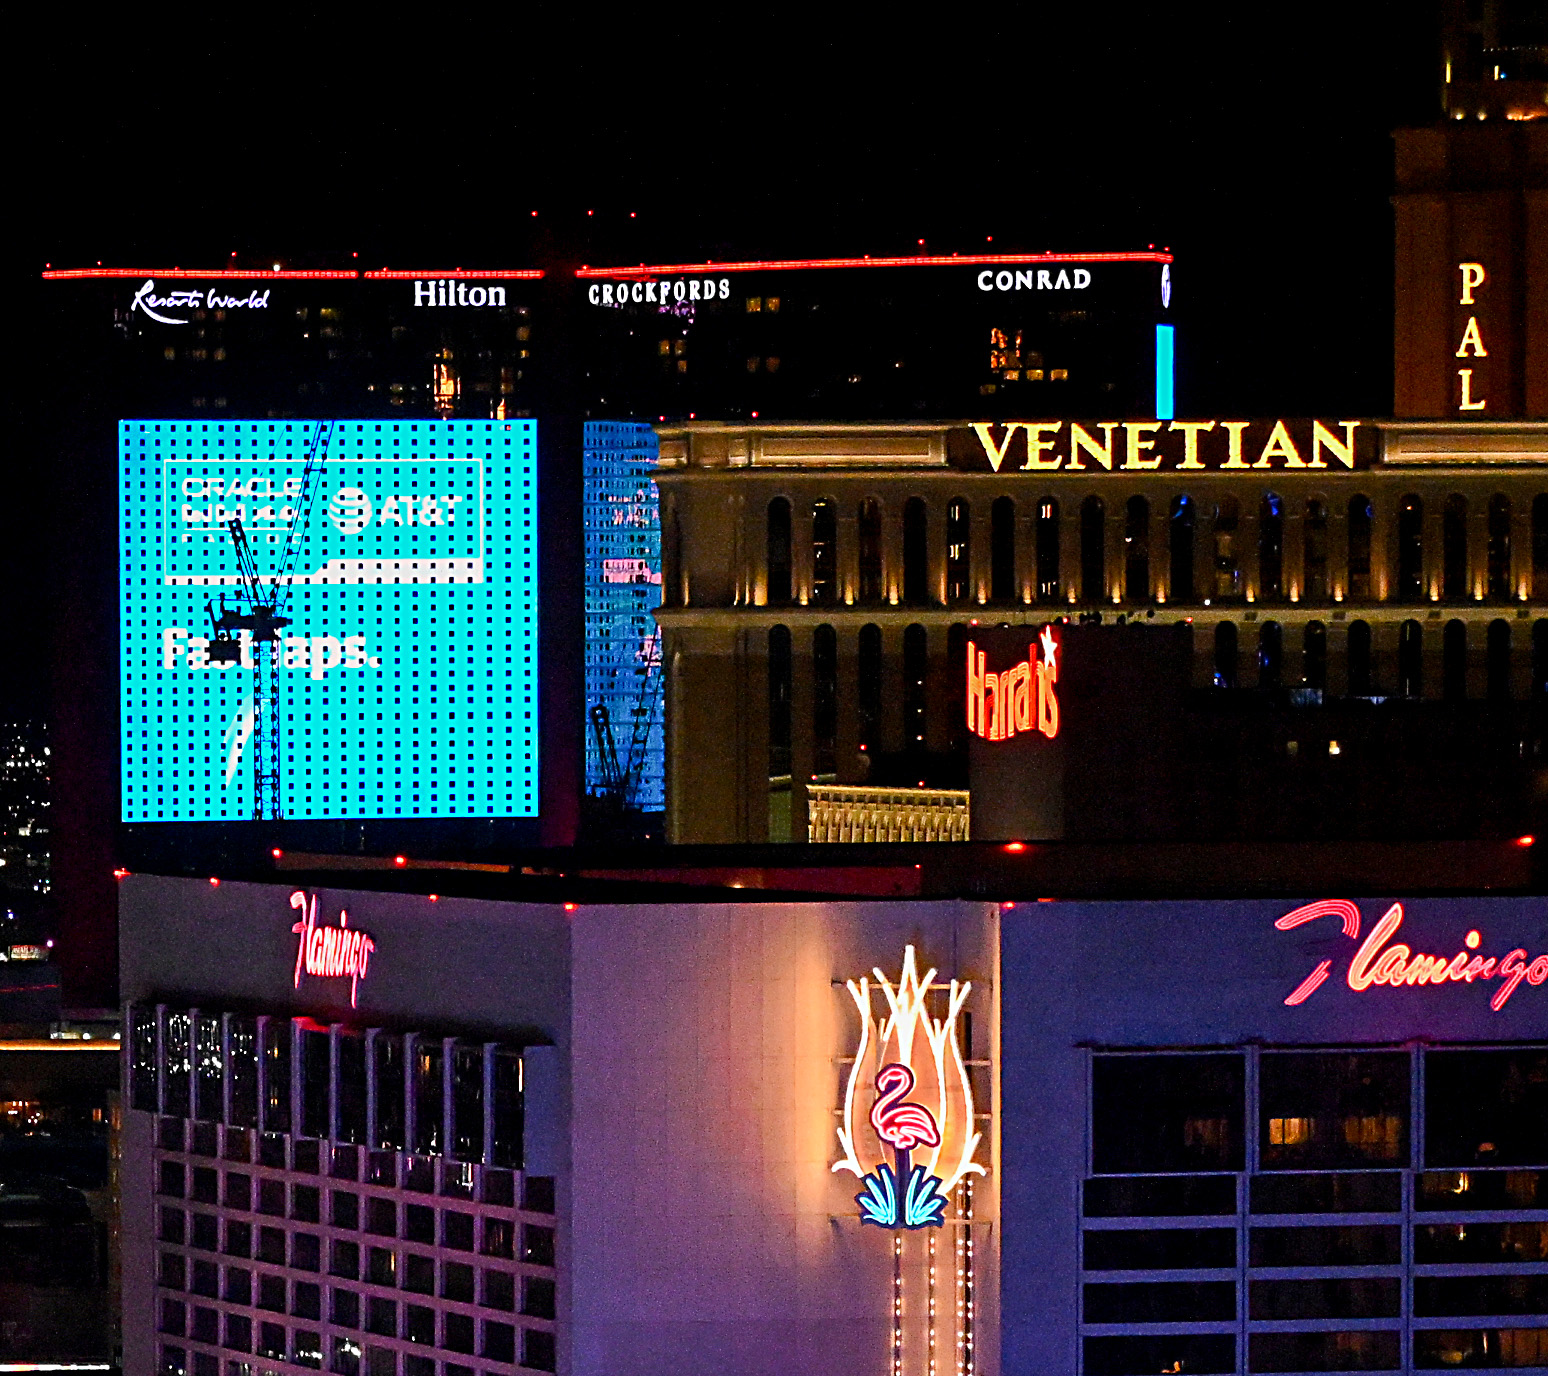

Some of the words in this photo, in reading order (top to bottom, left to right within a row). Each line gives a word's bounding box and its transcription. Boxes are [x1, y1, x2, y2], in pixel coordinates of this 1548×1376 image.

[414, 280, 506, 307] Hilton
[588, 279, 731, 305] CROCKFORDS
[977, 269, 1092, 292] CONRAD
[131, 279, 203, 324] Resorts
[207, 286, 270, 309] World
[968, 421, 1362, 471] VENETIAN
[181, 477, 302, 499] ORACLE
[379, 494, 464, 528] AT&T
[163, 627, 252, 670] Fat
[271, 628, 381, 681] aps.
[289, 890, 377, 1009] Flamingo
